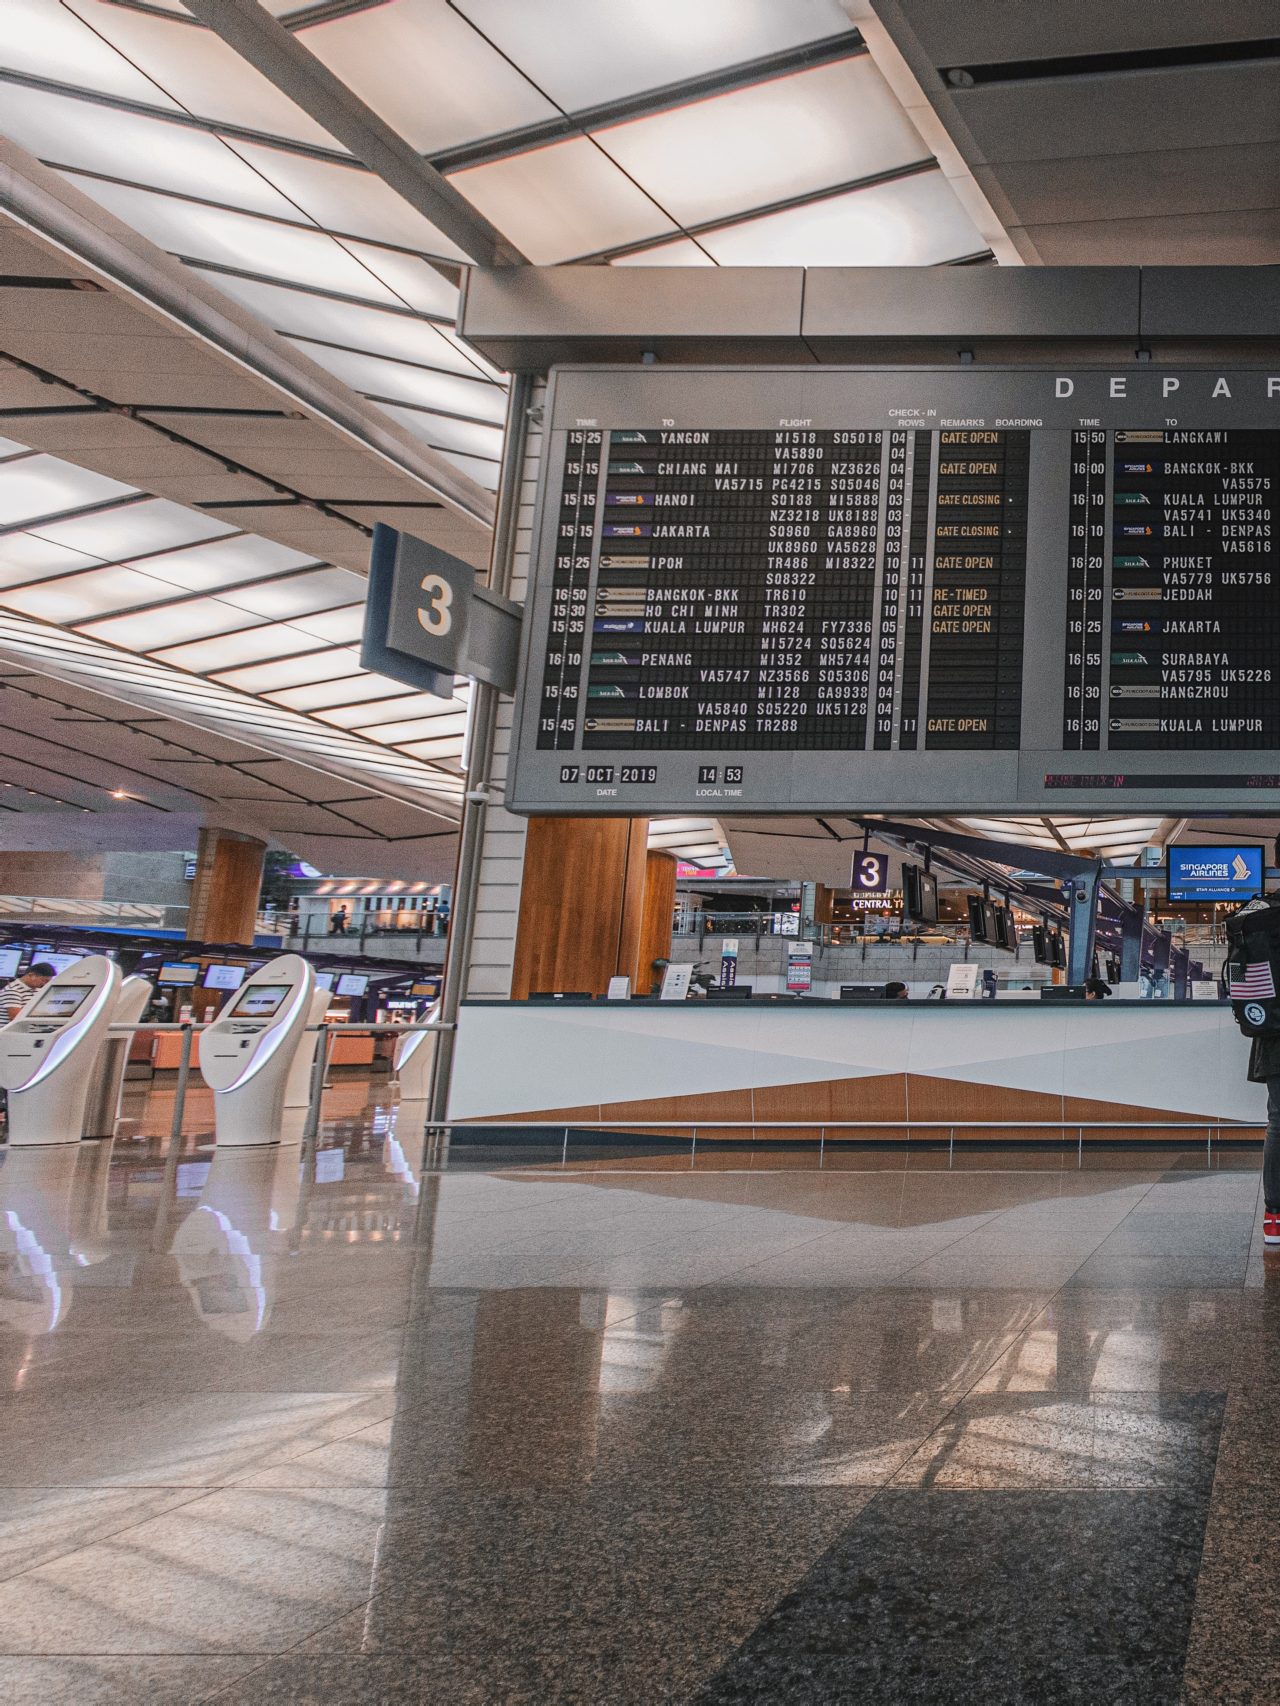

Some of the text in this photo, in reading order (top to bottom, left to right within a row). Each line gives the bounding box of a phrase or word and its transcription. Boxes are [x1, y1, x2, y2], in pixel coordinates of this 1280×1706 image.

[661, 433, 709, 443] YANGON
[776, 433, 816, 443] MI518
[834, 433, 883, 443] SQ5018
[942, 432, 998, 443] GATE OPEN
[1163, 432, 1227, 443] LANGKAWI
[775, 448, 823, 459] VA5890
[658, 463, 737, 474] CHIANG MAI
[832, 464, 881, 474] NZ3626
[940, 463, 996, 474] GATE OPEN
[715, 479, 762, 490] VA5715
[773, 479, 821, 490] PG4215
[655, 495, 694, 505] HANOI
[939, 495, 999, 504] GATE CLOSING
[1164, 494, 1262, 505] KUALA LUMPUR
[653, 526, 709, 537] JAKARTA
[828, 526, 878, 537] GA8960
[937, 527, 998, 536] GATE CLOSING
[1164, 526, 1193, 536] BALI
[1222, 525, 1270, 536] DENPAS
[652, 558, 682, 568] IPOH
[768, 557, 808, 568] TR486
[934, 557, 993, 568] GATE OPEN
[1164, 557, 1212, 568] PHUKET
[934, 589, 987, 600] RE-TIMED
[1163, 589, 1211, 600] JEDDAH
[417, 574, 454, 637] 3
[644, 605, 737, 616] HO CHI MINH
[932, 605, 991, 616] GATE OPEN
[645, 622, 744, 633] KUALA LUMPUR
[822, 622, 873, 633] FY7336
[931, 621, 990, 632] GATE OPEN
[1163, 621, 1220, 632] JAKARTA
[642, 654, 691, 665] PENANG
[1162, 654, 1228, 665] SURABAYA
[1162, 670, 1211, 681] VA5795
[640, 687, 688, 698] LOMBOK
[1160, 687, 1228, 698] HANGZHOU
[635, 720, 667, 731] BALI
[696, 720, 746, 731] DENPAS
[757, 720, 797, 731] TR288
[928, 719, 986, 731] GATE OPEN
[1159, 720, 1262, 731] KUALA LUMPUR
[860, 857, 880, 887] 3
[1180, 863, 1228, 871] SINGAPORE
